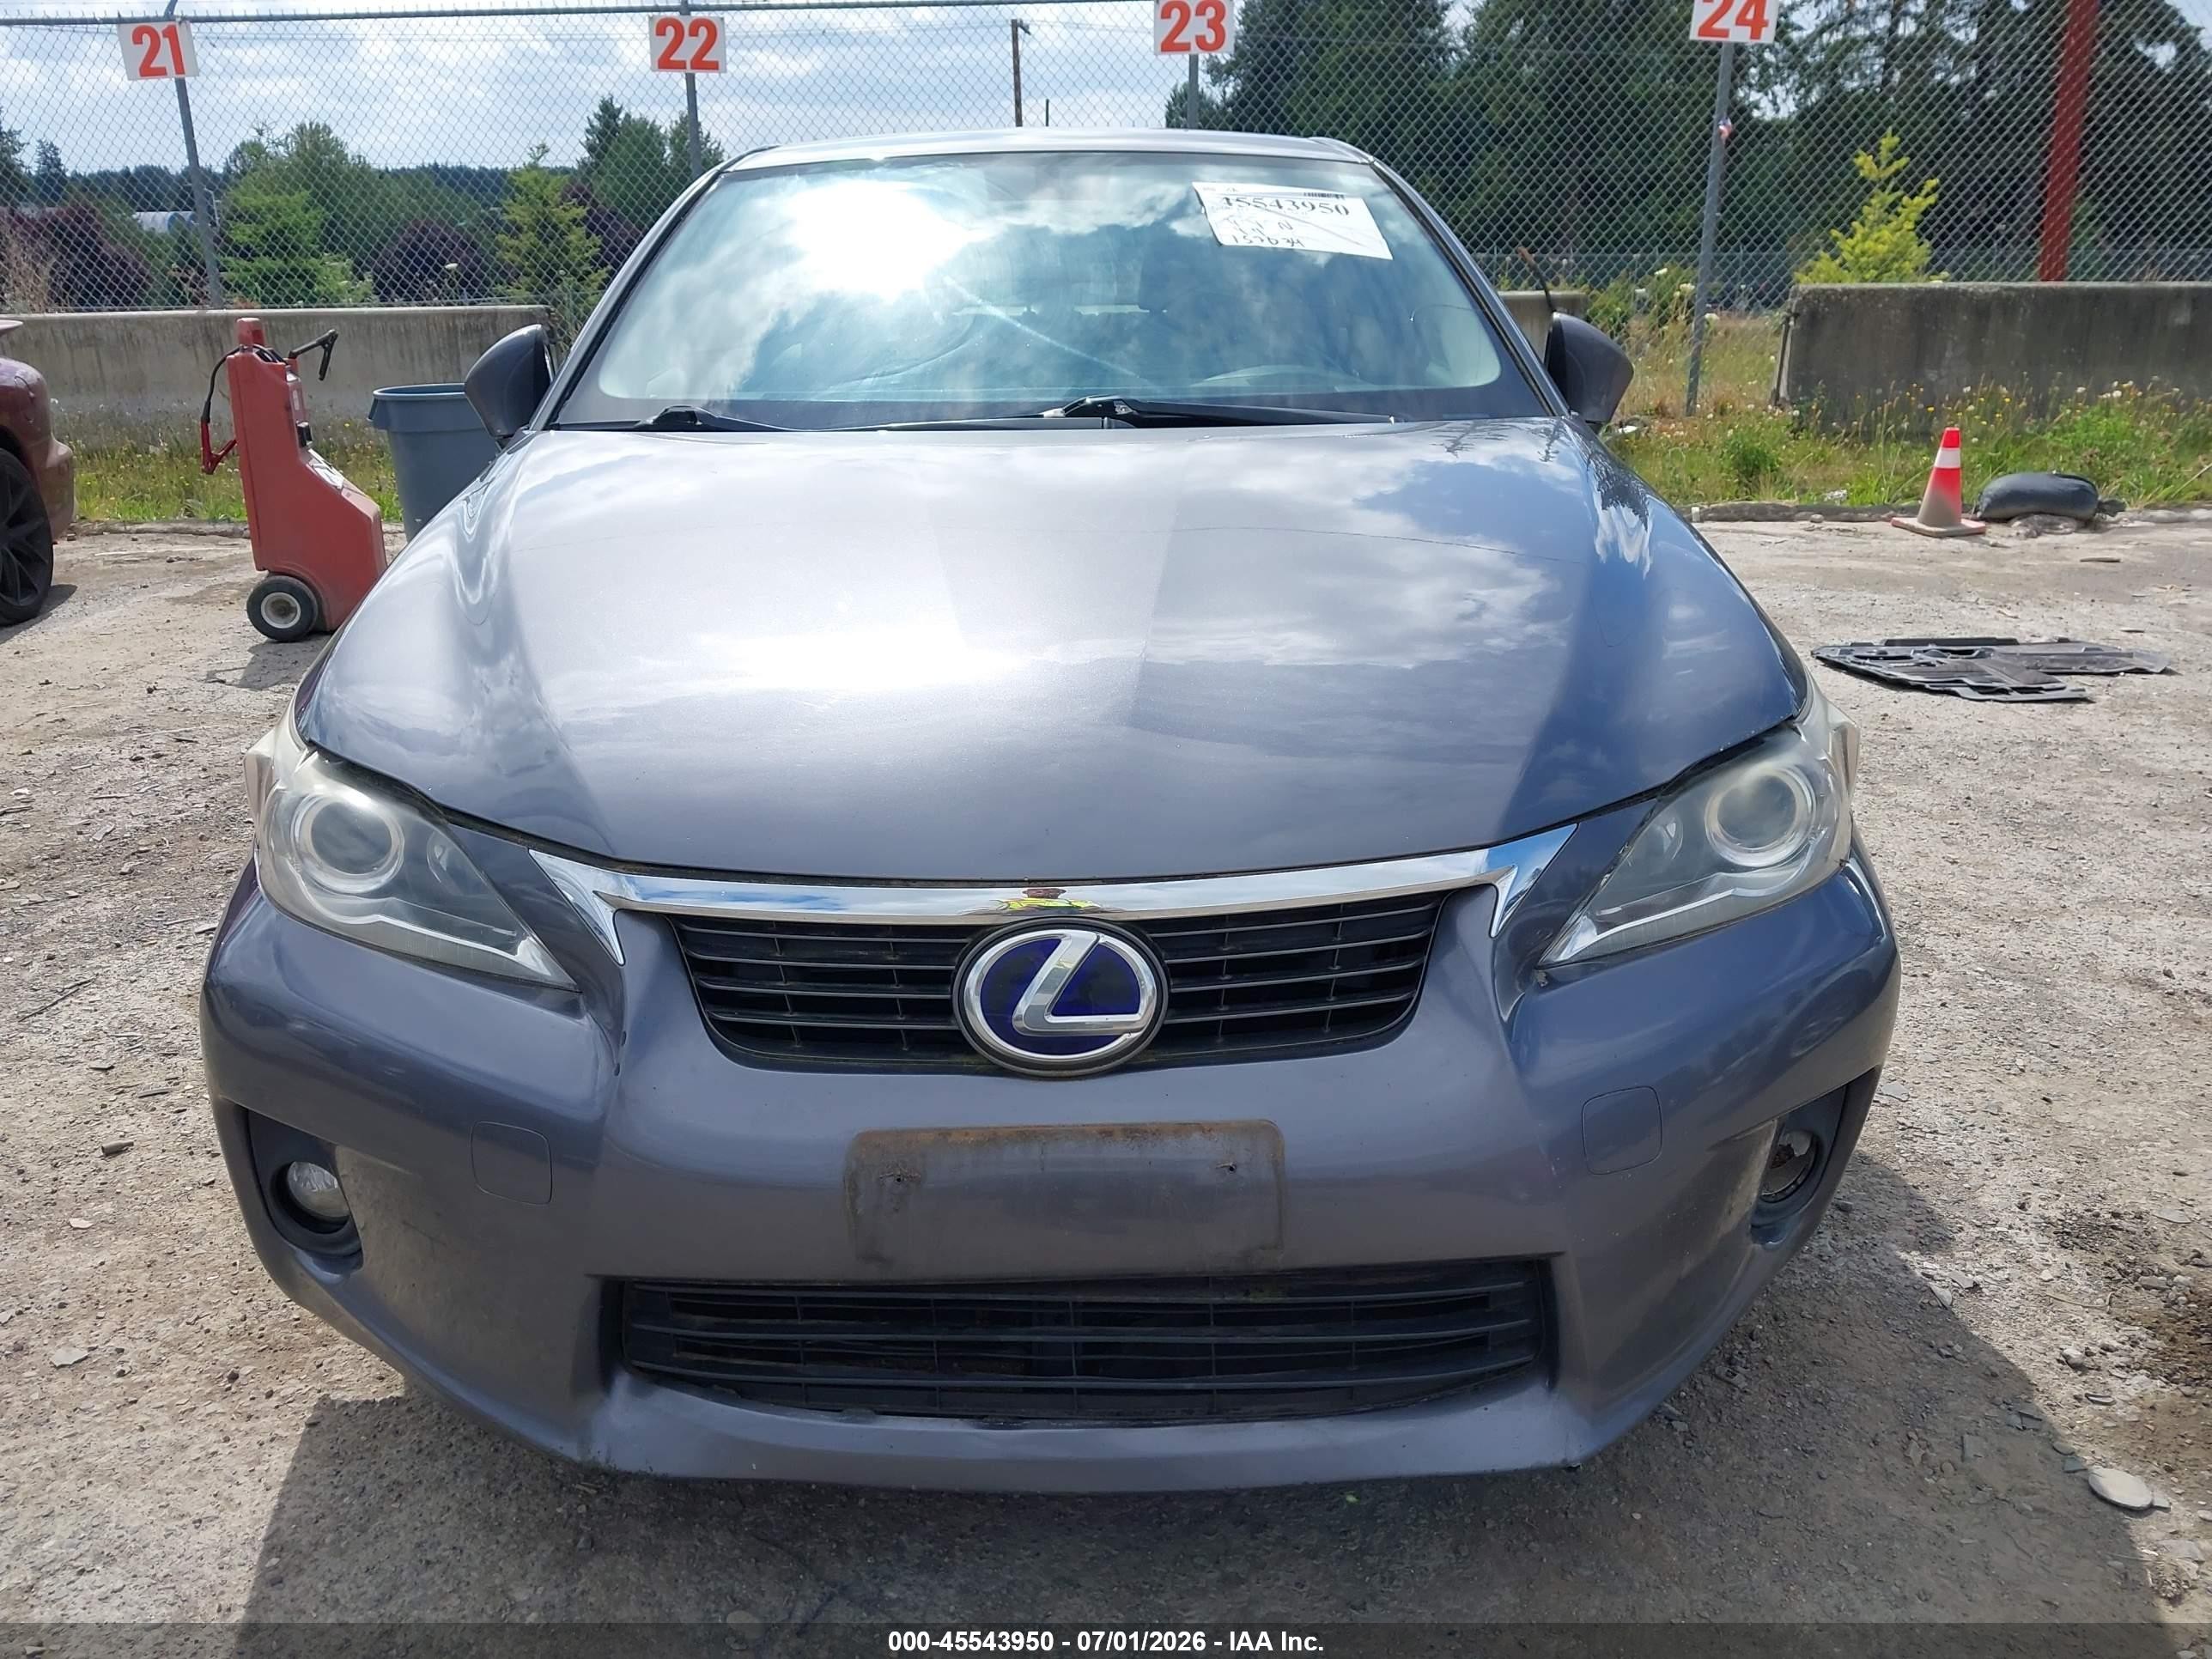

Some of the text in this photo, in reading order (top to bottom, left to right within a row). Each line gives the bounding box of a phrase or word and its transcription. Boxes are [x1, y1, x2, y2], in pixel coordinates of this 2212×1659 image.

[655, 18, 719, 70] 22
[1160, 0, 1225, 52] 23
[1698, 0, 1768, 40] 24
[132, 26, 185, 77] 21
